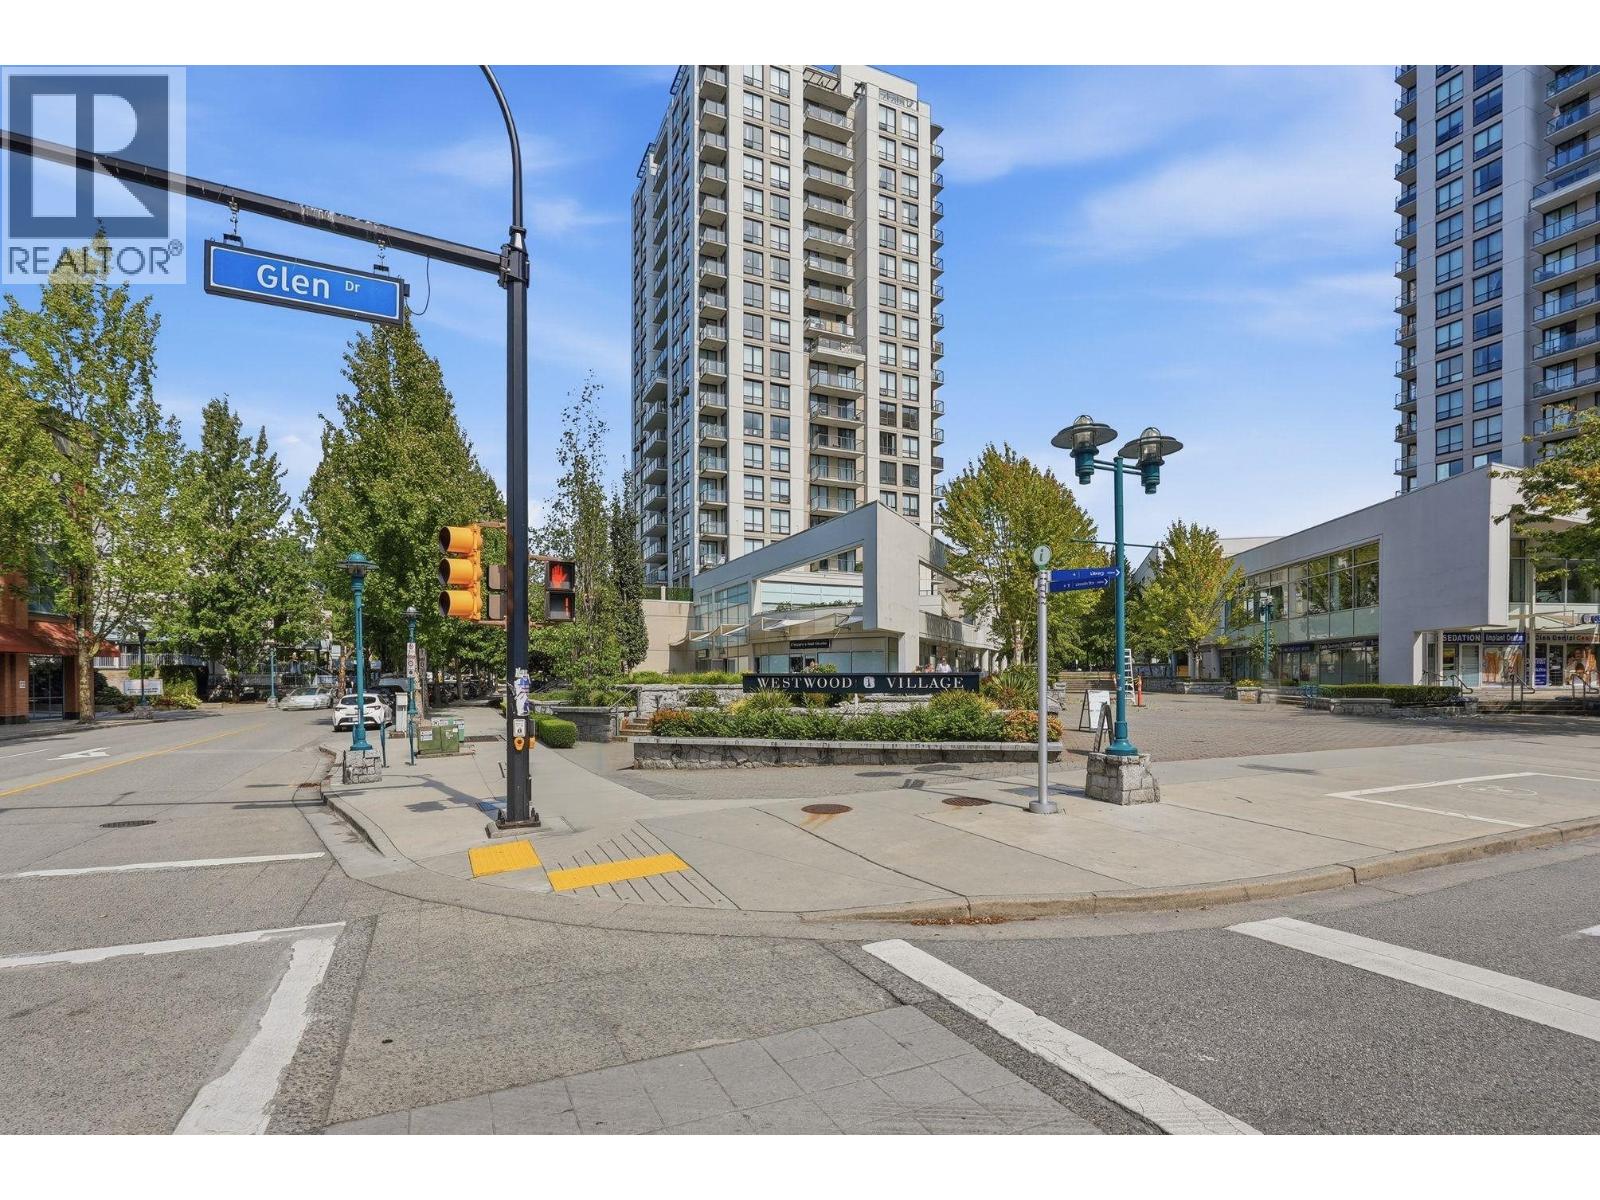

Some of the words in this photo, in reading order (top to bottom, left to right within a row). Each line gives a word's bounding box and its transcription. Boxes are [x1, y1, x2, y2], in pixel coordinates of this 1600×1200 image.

[257, 264, 330, 299] Glen
[345, 280, 361, 293] Dr
[1443, 634, 1481, 642] SEDATION
[757, 676, 852, 689] WESTWOOD
[887, 676, 964, 690] VILLAGE
